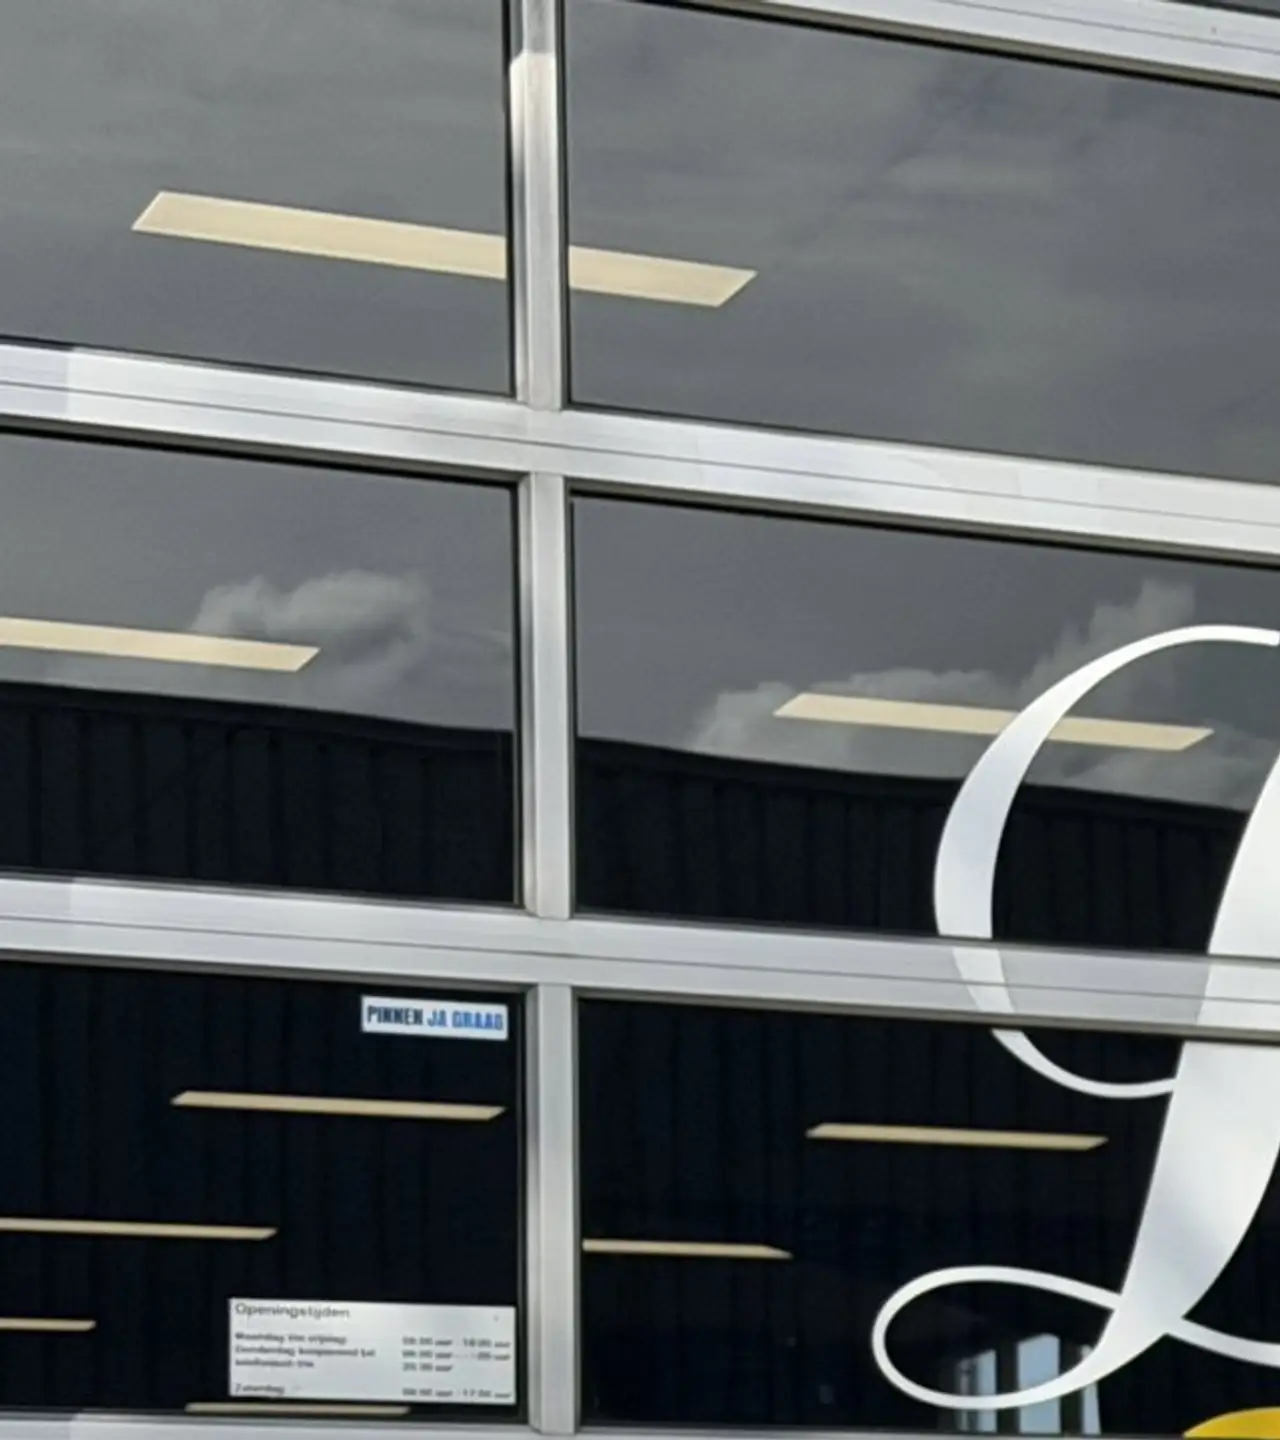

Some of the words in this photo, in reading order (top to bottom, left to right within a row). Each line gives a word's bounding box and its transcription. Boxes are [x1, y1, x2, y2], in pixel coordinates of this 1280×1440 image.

[366, 1004, 424, 1026] PINNEN
[427, 1008, 448, 1028] JA
[452, 1010, 504, 1031] GRAAG
